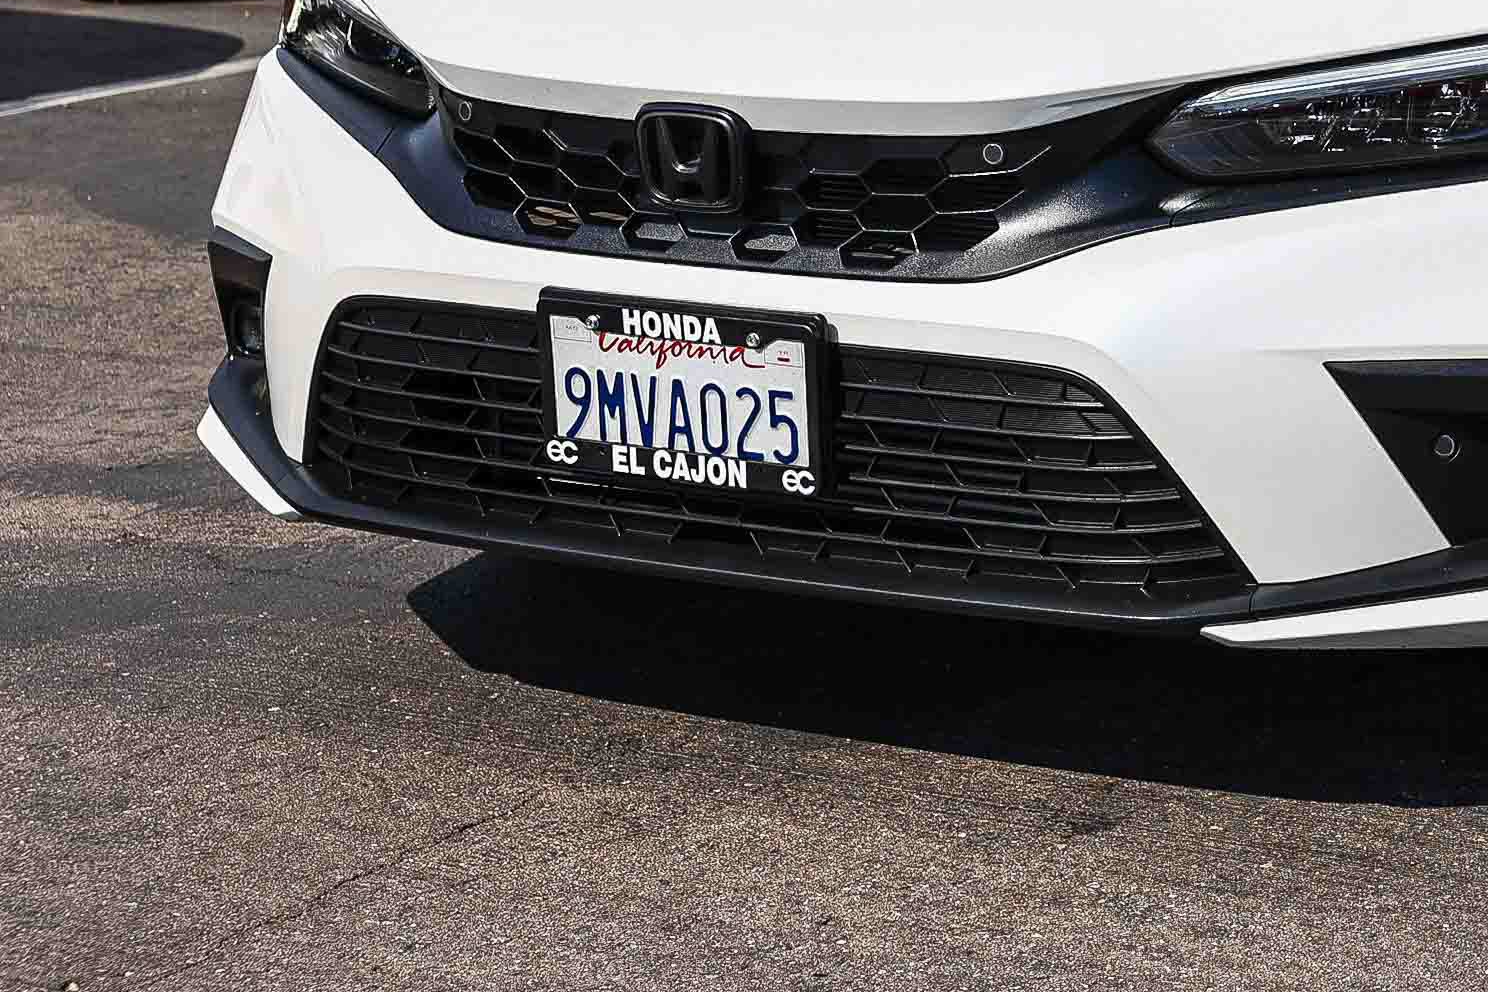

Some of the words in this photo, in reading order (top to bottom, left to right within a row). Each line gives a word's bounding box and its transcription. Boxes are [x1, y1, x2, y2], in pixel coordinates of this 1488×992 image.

[621, 308, 722, 345] HONDA
[598, 331, 766, 369] California
[564, 366, 800, 465] 9MVA025
[611, 444, 646, 476] EL
[652, 449, 748, 489] CAJON
